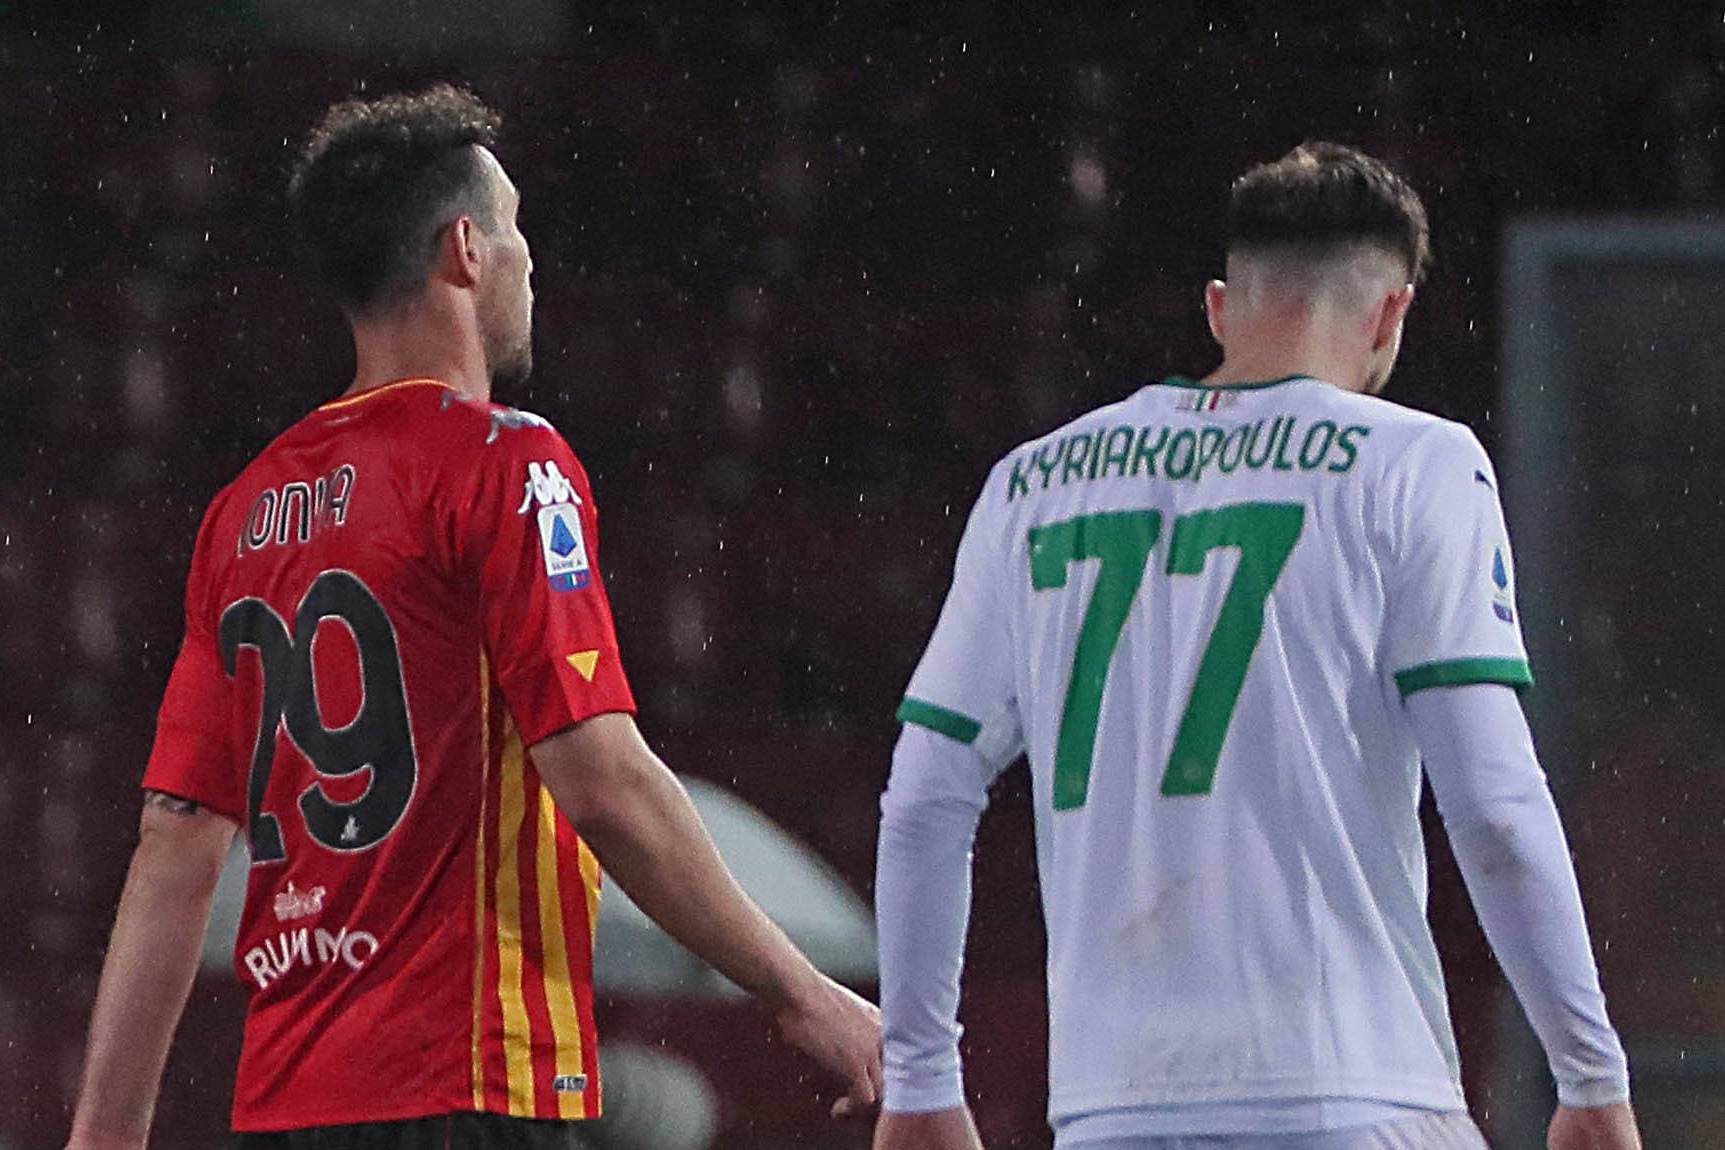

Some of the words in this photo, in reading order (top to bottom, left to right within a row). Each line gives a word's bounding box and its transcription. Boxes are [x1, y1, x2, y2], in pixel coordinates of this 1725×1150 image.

[1007, 415, 1371, 503] KYRIAKOPOULOS
[219, 568, 418, 866] 29
[1028, 501, 1307, 812] 77
